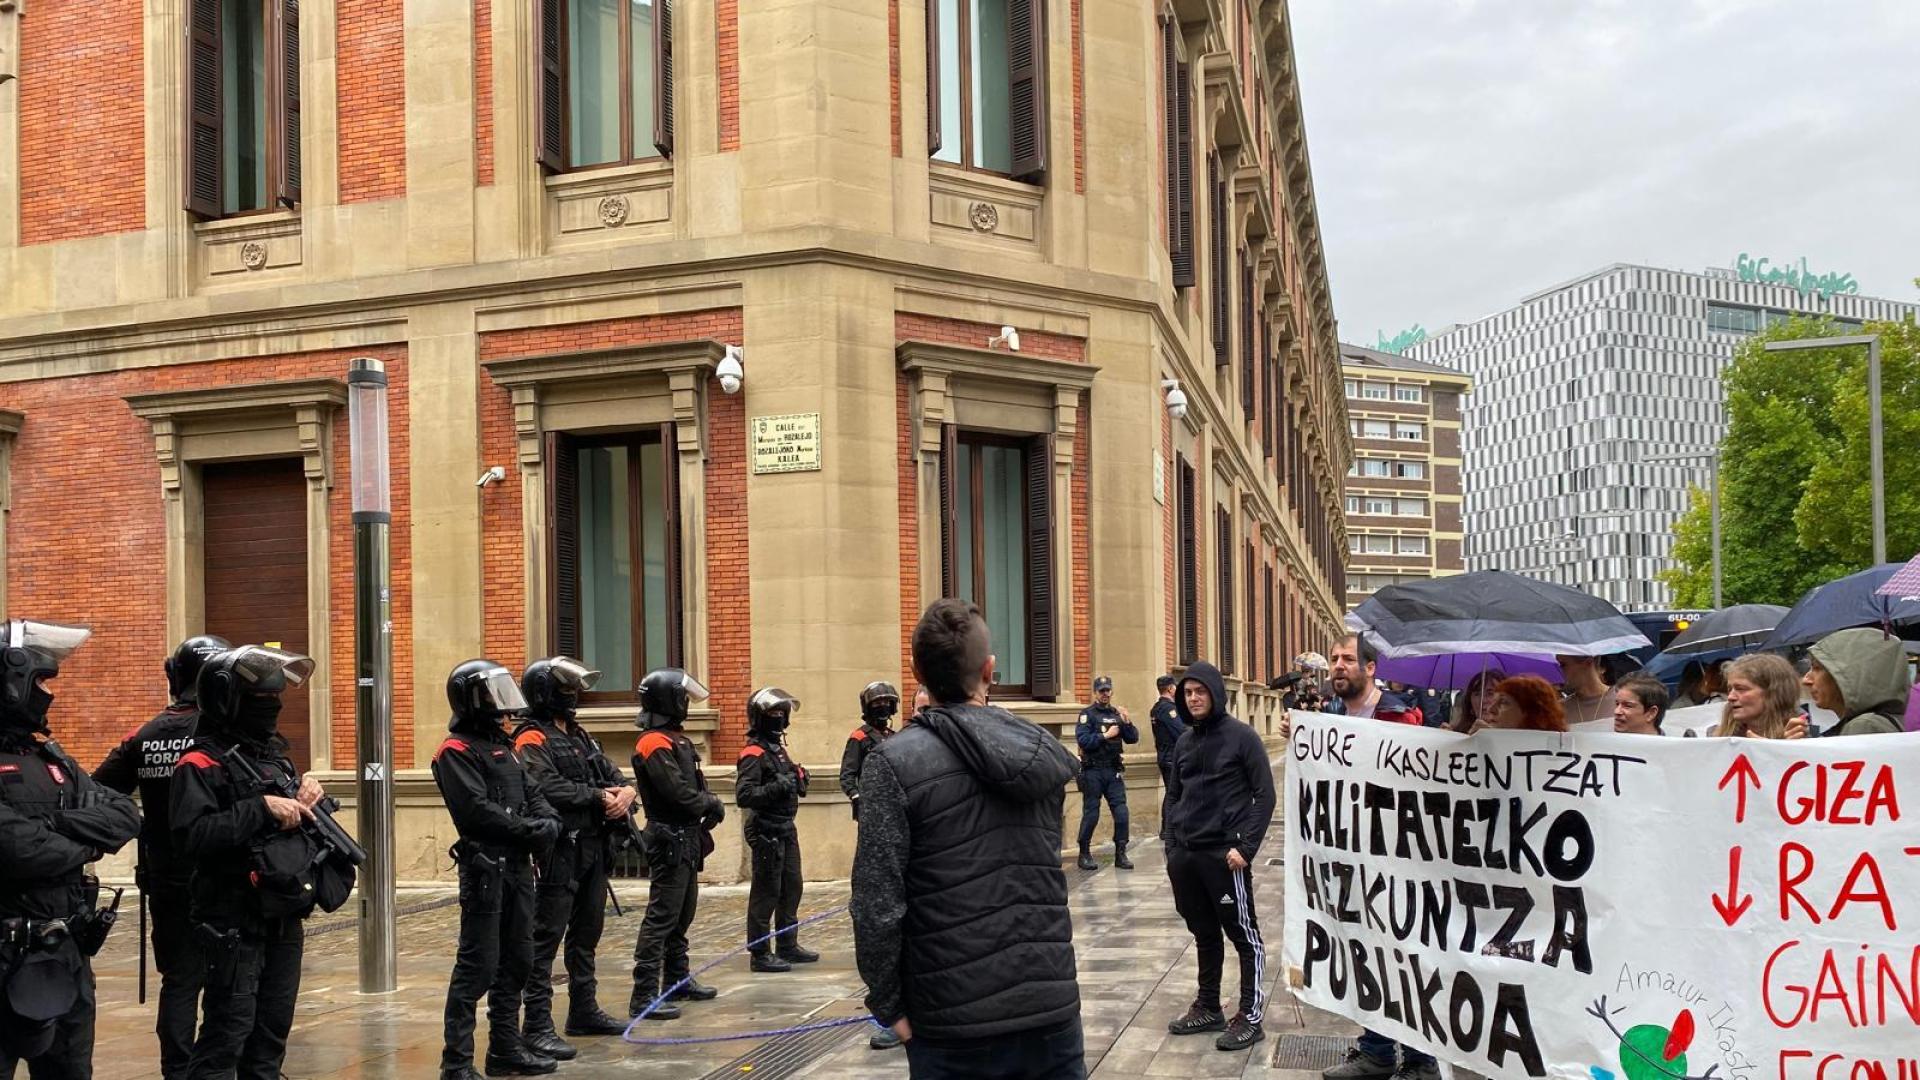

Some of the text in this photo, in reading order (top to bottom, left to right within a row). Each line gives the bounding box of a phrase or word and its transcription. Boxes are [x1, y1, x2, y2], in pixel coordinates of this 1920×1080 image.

[1293, 725, 1647, 798] GURE IKASLEENTZAT
[1776, 760, 1901, 825] GIZA
[1302, 854, 1594, 975] HEZKUNTZA
